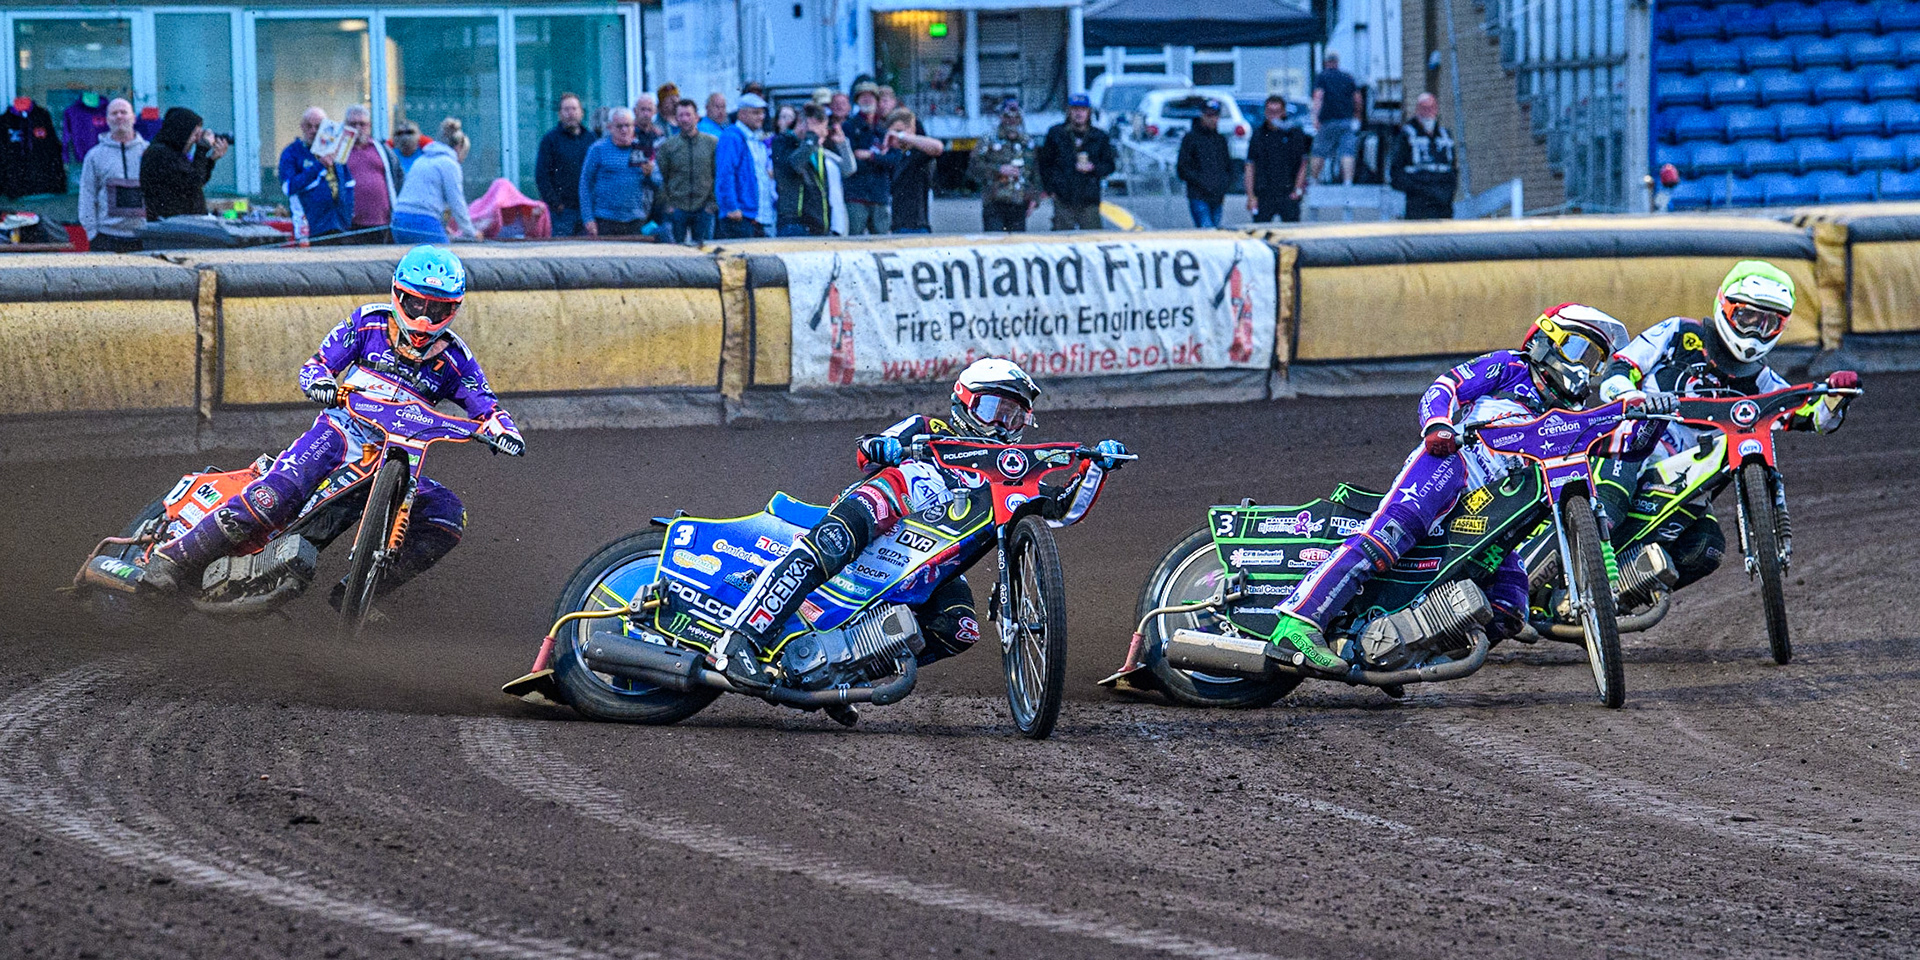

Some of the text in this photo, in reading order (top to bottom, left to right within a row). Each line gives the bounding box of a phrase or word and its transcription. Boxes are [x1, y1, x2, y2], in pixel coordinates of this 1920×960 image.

[872, 243, 1200, 302] Fenland Fire
[896, 303, 1195, 344] Fire Protection Engineers
[881, 336, 1204, 381] www.flandfire.co.uk
[395, 409, 434, 425] Crendon
[1537, 420, 1581, 437] Crendon
[943, 449, 989, 461] POLCOPPER
[1418, 454, 1457, 498] CITY AUCTION
[1434, 467, 1456, 492] GROUP
[1216, 514, 1234, 536] 3
[1455, 519, 1482, 529] ASFALT
[673, 525, 694, 546] 3
[898, 531, 934, 552] DVR
[857, 564, 890, 580] DOCUFY
[762, 558, 814, 614] CELKA
[832, 575, 871, 596] MOTOREX
